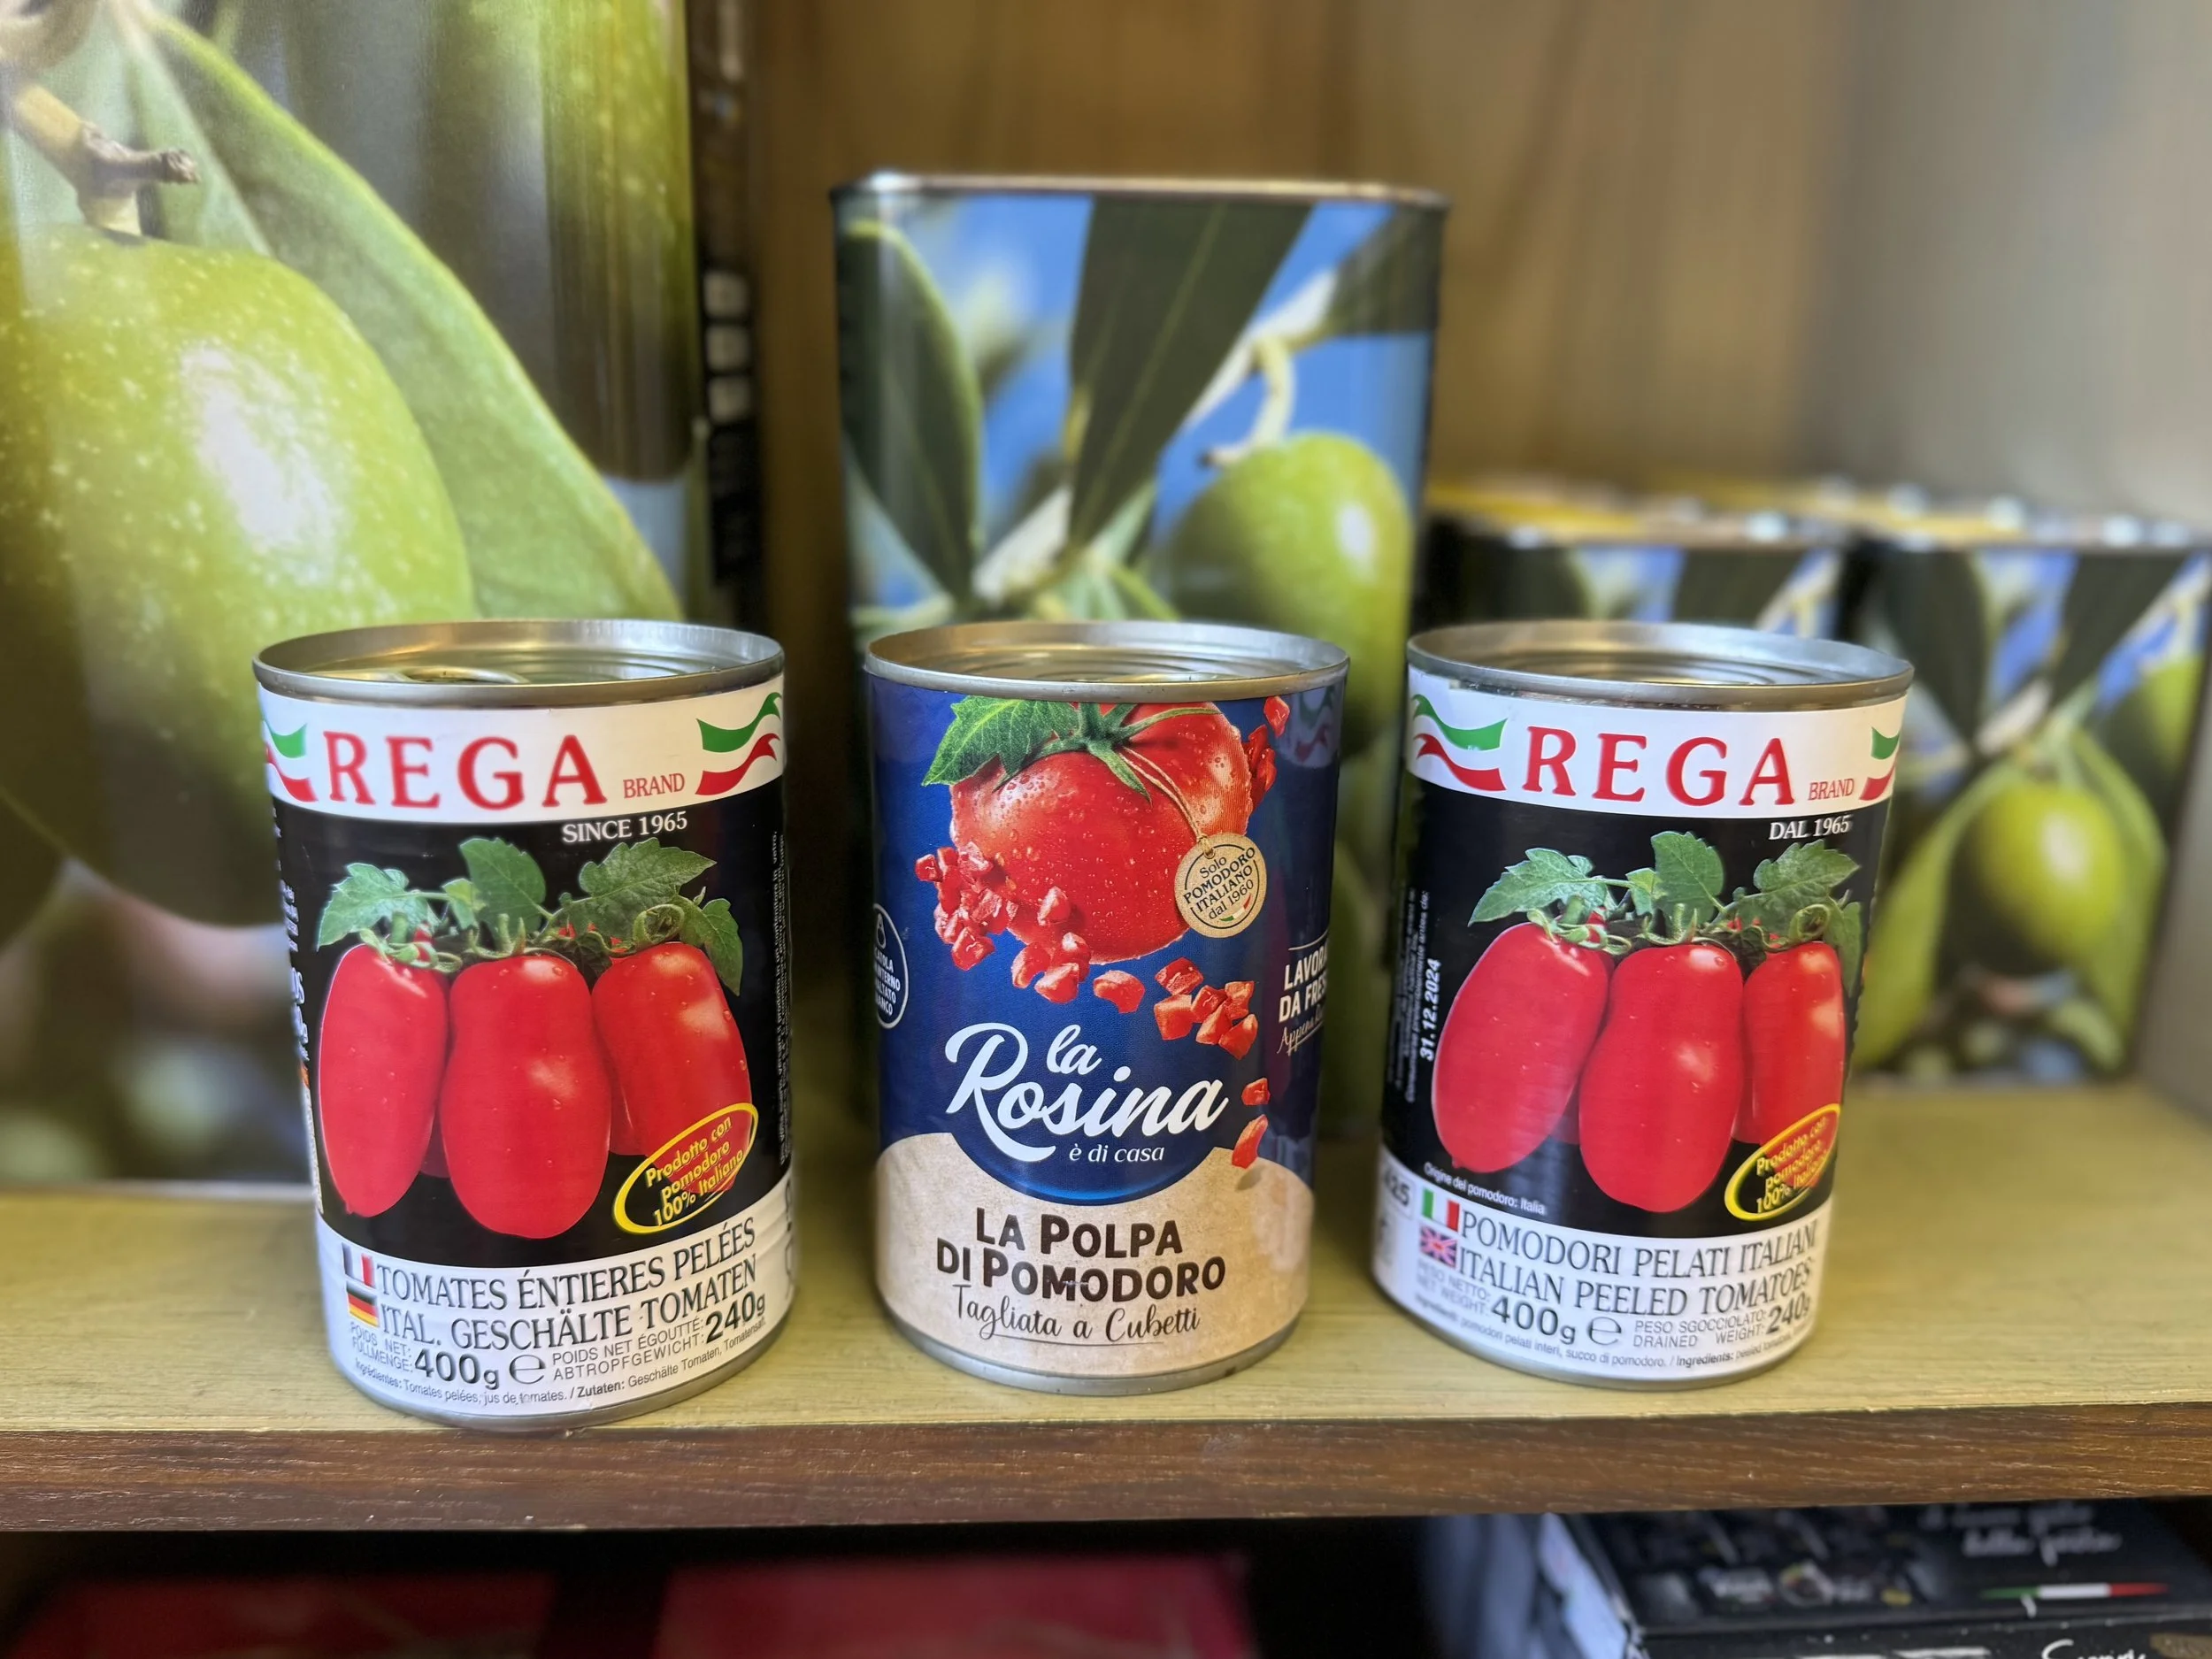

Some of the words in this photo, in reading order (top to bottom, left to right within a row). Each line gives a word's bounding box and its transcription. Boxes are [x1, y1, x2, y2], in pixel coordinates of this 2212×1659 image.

[322, 731, 608, 811] REGA
[623, 772, 687, 799] BRAND
[1521, 726, 1795, 807] REGA
[1807, 778, 1855, 802] BRAND
[561, 819, 632, 844] SINCE
[638, 811, 688, 835] 1965
[1769, 820, 1810, 841] DAL
[1813, 814, 1852, 837] 1965
[1183, 847, 1256, 904] POMODORO
[1196, 865, 1252, 912] ITALIANO
[1200, 856, 1227, 879] Solo
[1209, 901, 1228, 920] dal
[1227, 879, 1254, 906] 1960
[1279, 991, 1301, 1023] DA
[1419, 957, 1442, 1062] 31.12.2024
[1047, 1024, 1102, 1075] la
[944, 1022, 1229, 1162] Rosina
[646, 1138, 708, 1188] Prodotto
[710, 1117, 733, 1143] con
[661, 1141, 730, 1205] pomodoro
[1069, 1143, 1082, 1162] è
[1087, 1143, 1107, 1163] di
[1113, 1146, 1164, 1162] casa
[1756, 1133, 1809, 1177] Prodotto
[653, 1190, 696, 1226] 100%
[699, 1149, 745, 1197] Italiano
[1453, 1175, 1467, 1191] del
[1467, 1183, 1518, 1208] pomodoro:
[1520, 1197, 1547, 1215] Italia
[1756, 1183, 1793, 1213] 100%
[976, 1207, 1025, 1250] LA
[1041, 1213, 1183, 1258] POLPA
[1462, 1210, 1621, 1275] POMODORI
[1632, 1247, 1730, 1279] PELATI
[1738, 1219, 1817, 1275] ITALIANI
[376, 1263, 508, 1310] TOMATES
[518, 1256, 664, 1310] ÉNTIERES
[672, 1217, 756, 1281] PELÉES
[936, 1237, 971, 1281] DI
[983, 1256, 1226, 1302] POMODORO
[1459, 1245, 1564, 1308] ITALIAN
[1574, 1279, 1688, 1317] PEELED
[1699, 1257, 1812, 1317] TOMATOES
[380, 1303, 442, 1346] ITAL.
[451, 1304, 634, 1351] GESCHÄLTE
[641, 1253, 757, 1330] TOMATEN
[952, 1284, 1063, 1340] Tagliata
[1072, 1318, 1094, 1339] a
[1105, 1303, 1202, 1343] Cubetti
[1492, 1294, 1576, 1345] 400g
[1634, 1319, 1673, 1334] PESO
[1678, 1309, 1767, 1333] SGOCCIOLATO:
[350, 1321, 378, 1347] POIDS
[385, 1340, 411, 1357] NET:
[552, 1348, 598, 1366] POIDS
[604, 1340, 633, 1357] NET
[638, 1315, 704, 1349] ÉGOUTTÉ:
[553, 1333, 705, 1381] ABTROPFGEWICHT:
[705, 1291, 766, 1344] 240g
[1504, 1332, 1532, 1350] pelati
[1534, 1340, 1563, 1358] interi,
[1565, 1348, 1596, 1363] succo
[1599, 1349, 1609, 1363] di
[1611, 1353, 1667, 1367] pomodoro.
[1677, 1350, 1734, 1368] Ingredients:
[1633, 1334, 1698, 1348] DRAINED
[1715, 1325, 1765, 1344] WEIGHT:
[403, 1379, 442, 1400] Tomates
[484, 1391, 500, 1405] jus
[577, 1380, 625, 1399] Zutaten:
[628, 1365, 679, 1387] Geschälte
[680, 1347, 723, 1371] Tomaten,
[414, 1348, 500, 1390] 400g
